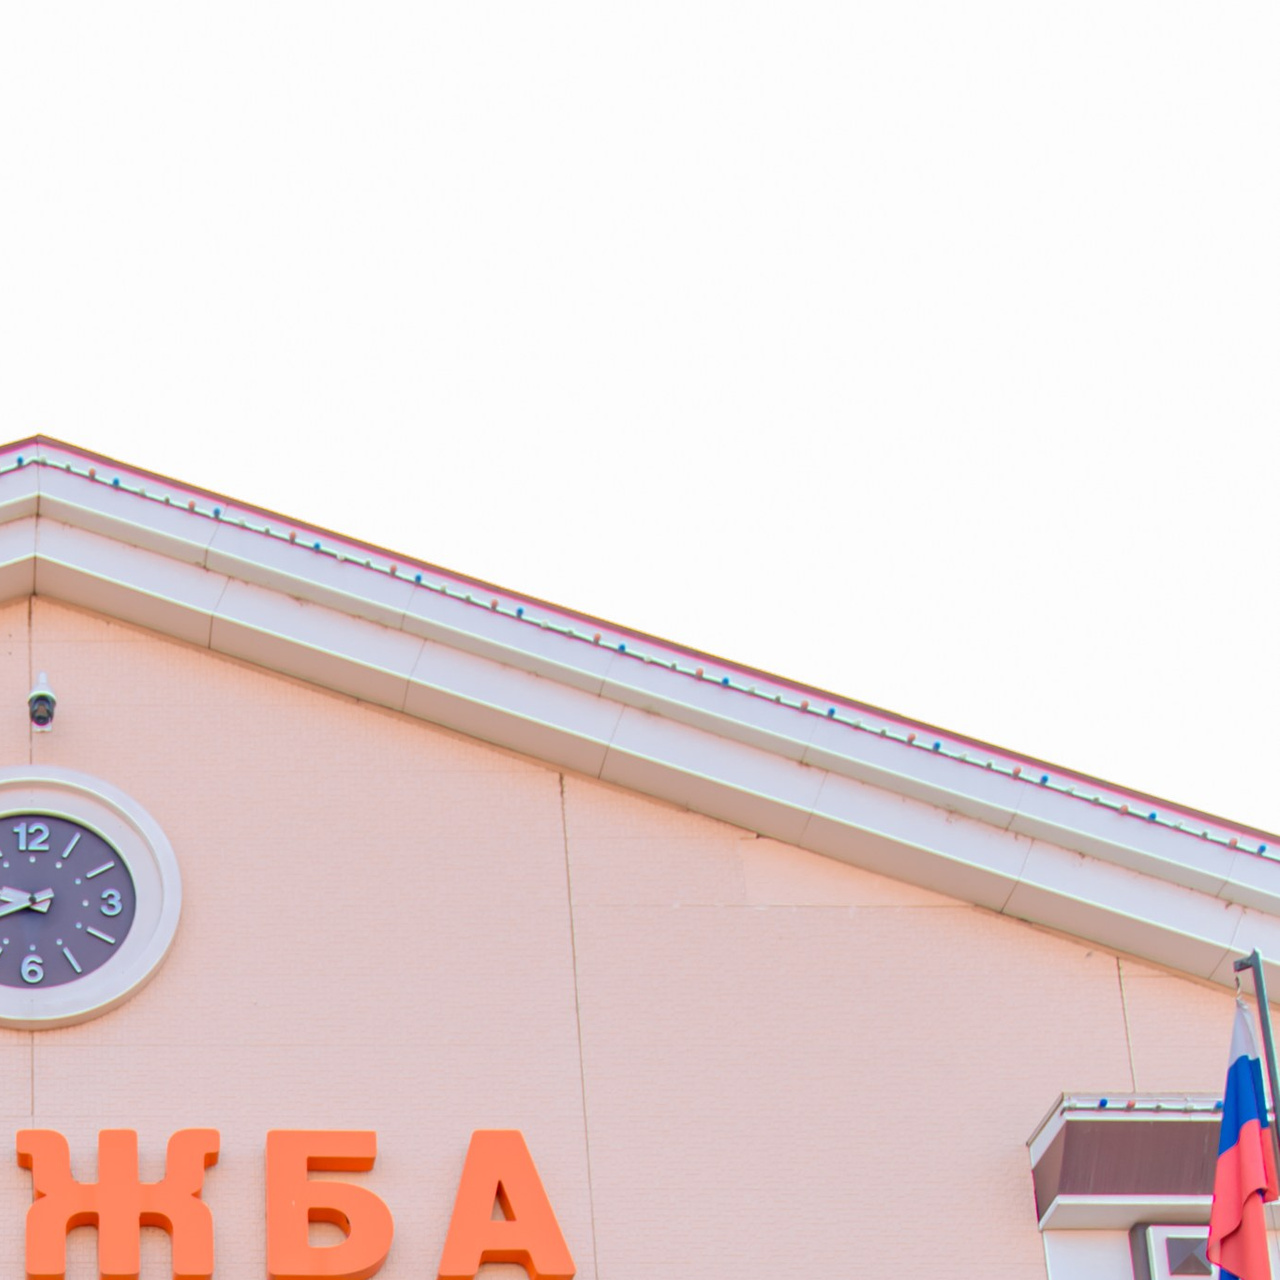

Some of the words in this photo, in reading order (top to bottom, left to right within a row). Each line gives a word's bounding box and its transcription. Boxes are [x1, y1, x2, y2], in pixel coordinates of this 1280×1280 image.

[12, 822, 51, 852] 12
[100, 888, 123, 917] 3
[20, 954, 45, 984] 6
